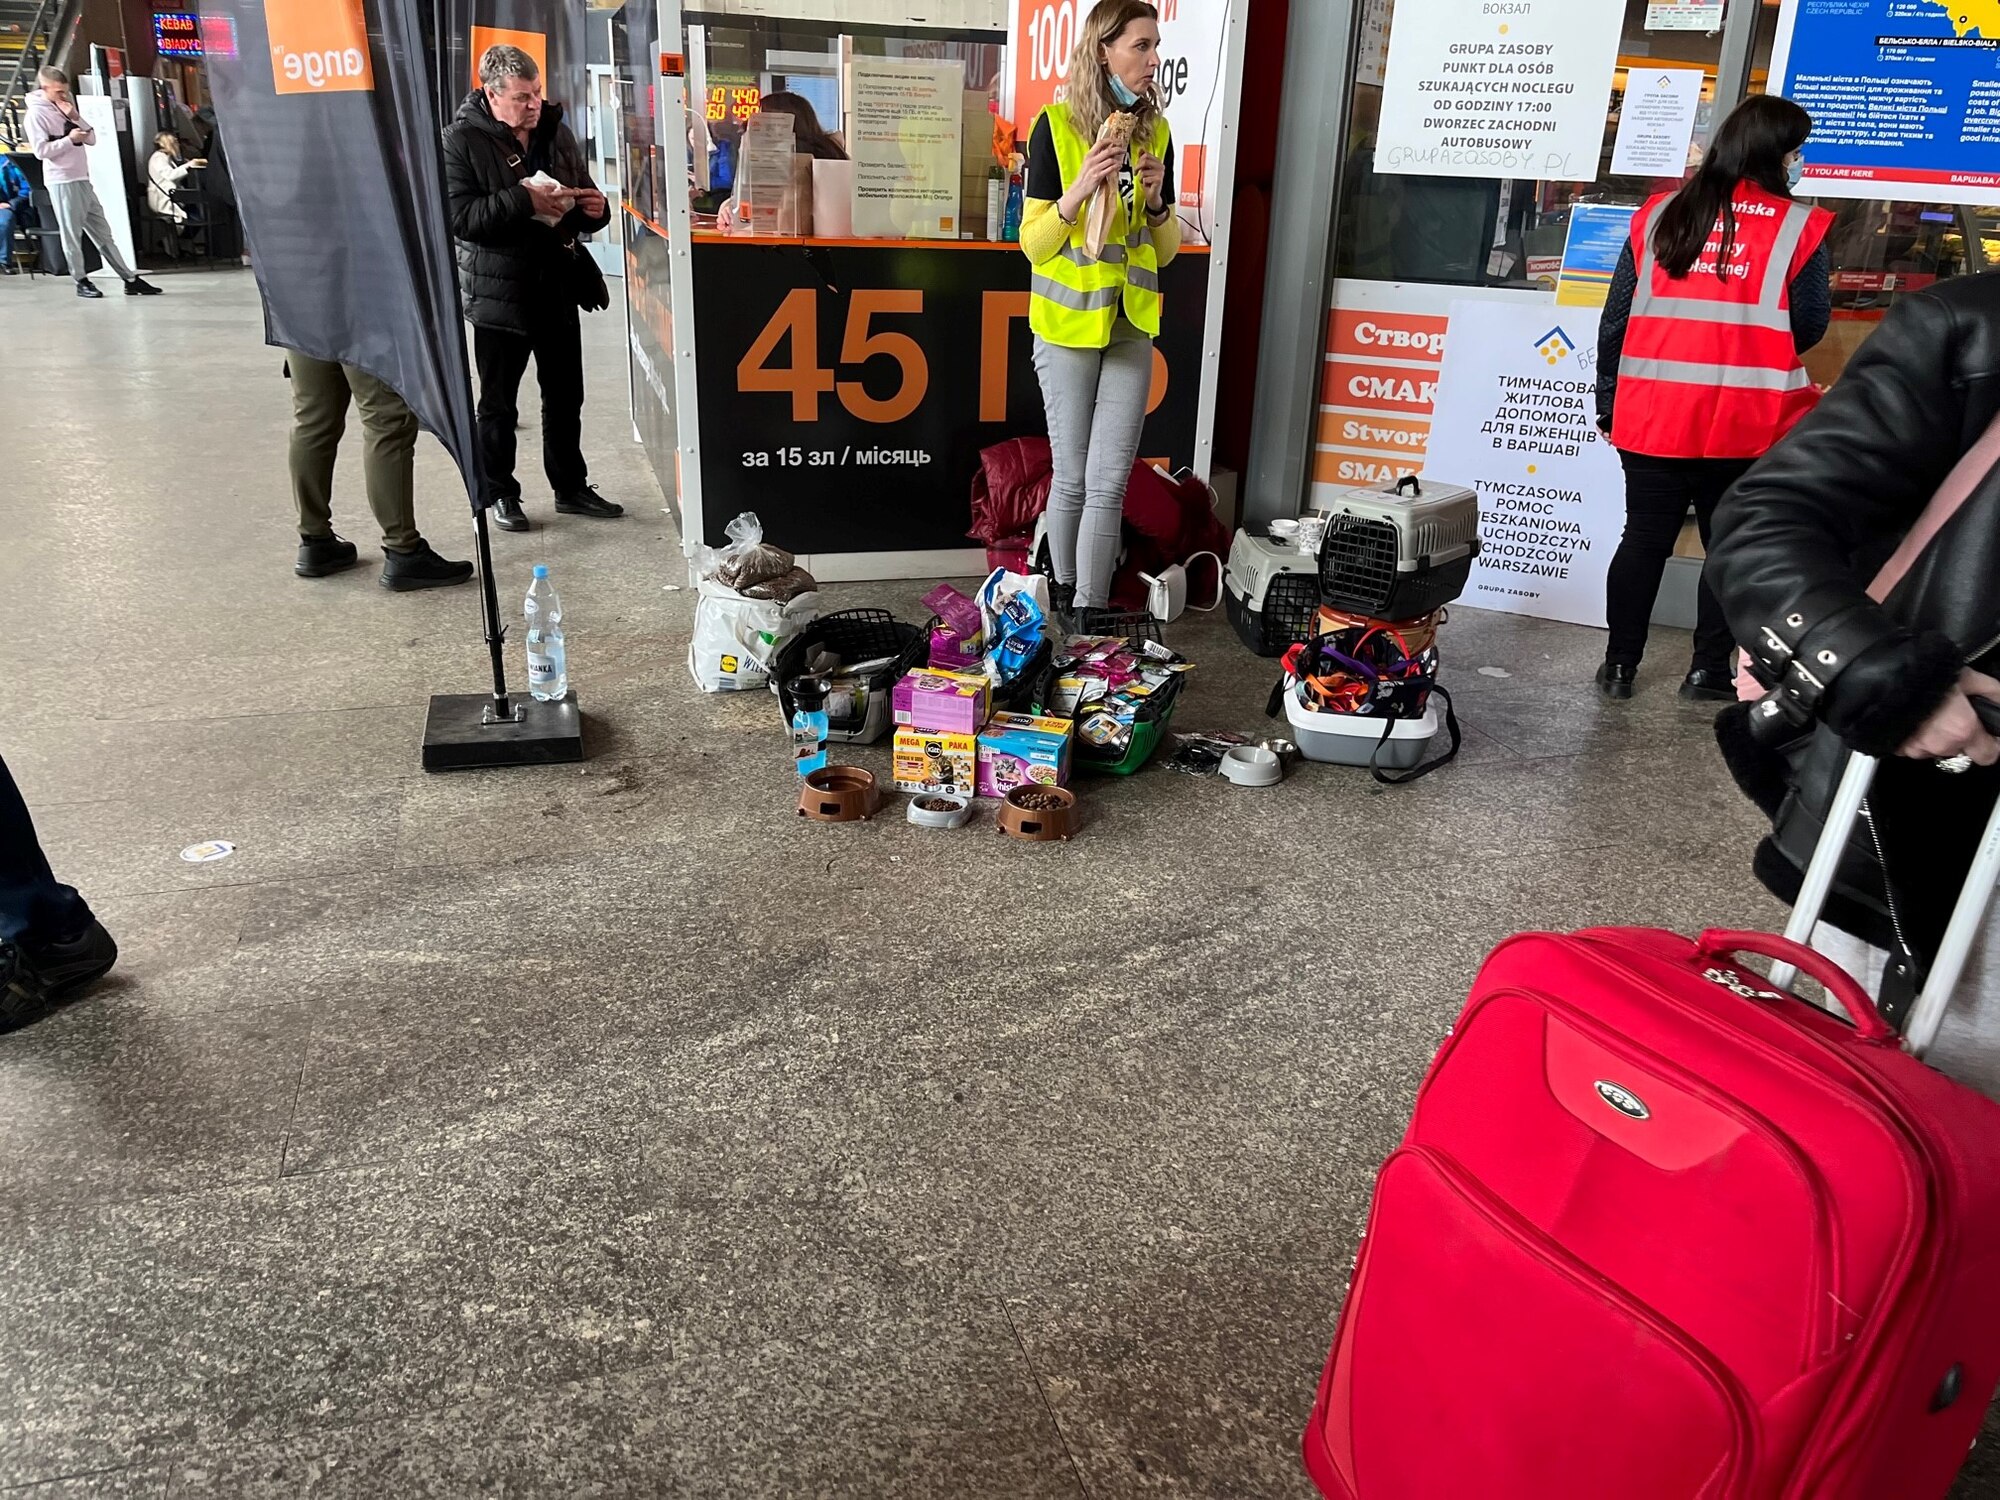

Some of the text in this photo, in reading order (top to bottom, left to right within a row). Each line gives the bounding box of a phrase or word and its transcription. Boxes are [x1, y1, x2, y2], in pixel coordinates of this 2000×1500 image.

[1482, 3, 1532, 15] ВОКЗАЛ
[160, 18, 194, 31] KEBAB
[1028, 1, 1074, 81] 100
[1449, 44, 1554, 55] GRUPA ZASOBY
[1442, 61, 1554, 75] PUNKT DLA OSÓB
[1796, 74, 1831, 82] Маленькі
[1832, 75, 1853, 83] міста
[1861, 76, 1889, 85] Польщі
[1891, 78, 1933, 86] означають
[1418, 81, 1575, 95] SZUKAJĄCYCH NOCLEGU
[1794, 83, 1819, 91] більші
[1820, 84, 1866, 92] можливості
[1883, 87, 1932, 95] проживання
[1868, 95, 1893, 103] нижчу
[1895, 96, 1927, 104] вартість
[1433, 100, 1552, 113] OD GODZINY 17:00
[1868, 103, 1895, 112] Великі
[1896, 105, 1917, 113] міста
[1918, 106, 1948, 114] Польщі
[1972, 108, 1987, 116] job.
[1423, 118, 1557, 132] DWORZEC ZACHODNI
[1857, 121, 1877, 129] села,
[1878, 131, 1898, 139] дуже
[1960, 135, 1981, 143] good
[1441, 137, 1532, 150] AUTOBUSOWY
[1854, 139, 1904, 147] проживання.
[1815, 168, 1832, 176] YOU
[1851, 170, 1874, 178] HERE
[1951, 175, 1994, 184] ВАРШАВА
[737, 288, 929, 424] 45
[1498, 375, 1597, 395] ТИМЧАСОВА
[1504, 391, 1585, 410] ЖИТЛОВА
[1495, 407, 1588, 426] ДОПОМОГА
[1481, 421, 1597, 444] ДЛЯ БІЖЕНЦІВ
[1492, 437, 1581, 458] В ВАРШАВІ
[742, 445, 932, 467] за 15 зл / місяць
[1474, 479, 1583, 504] TYMCZASOWA
[1495, 498, 1554, 515] POMOC
[1478, 511, 1582, 535] ESZKANIOWA
[1483, 525, 1591, 551] UCHODŹCZYŃ
[1478, 556, 1569, 579] WARSZAWIE
[1477, 584, 1541, 599] GRUPA ZASOBY
[899, 737, 968, 750] MEGA PAKA
